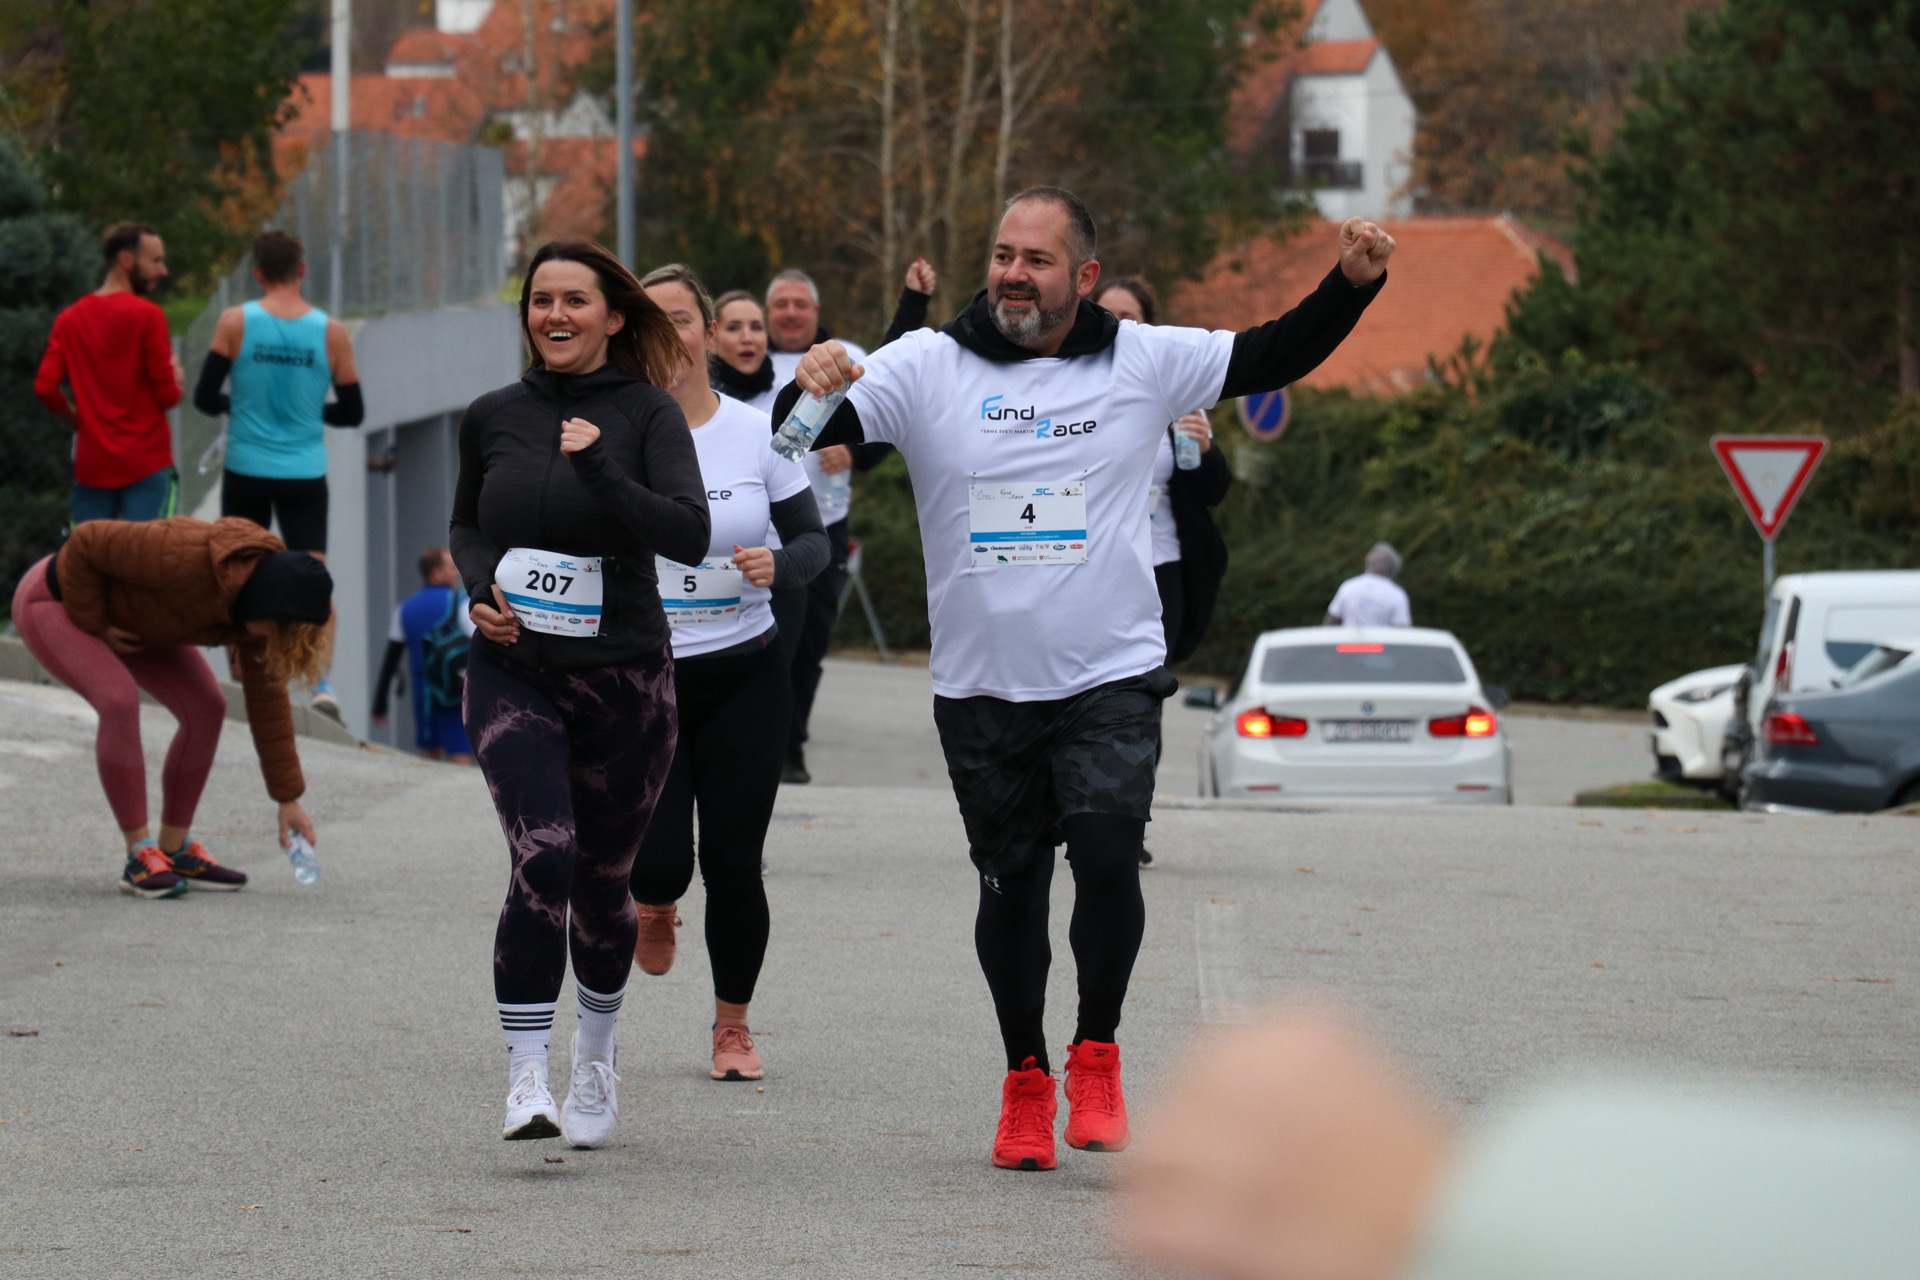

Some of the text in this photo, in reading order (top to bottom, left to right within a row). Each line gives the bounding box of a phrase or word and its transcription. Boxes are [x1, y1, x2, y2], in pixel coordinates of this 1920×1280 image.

[981, 394, 1035, 421] Fund
[1036, 418, 1097, 439] Race
[707, 490, 733, 500] ce
[1019, 503, 1036, 524] 4
[525, 569, 575, 596] 207
[683, 575, 697, 593] 5
